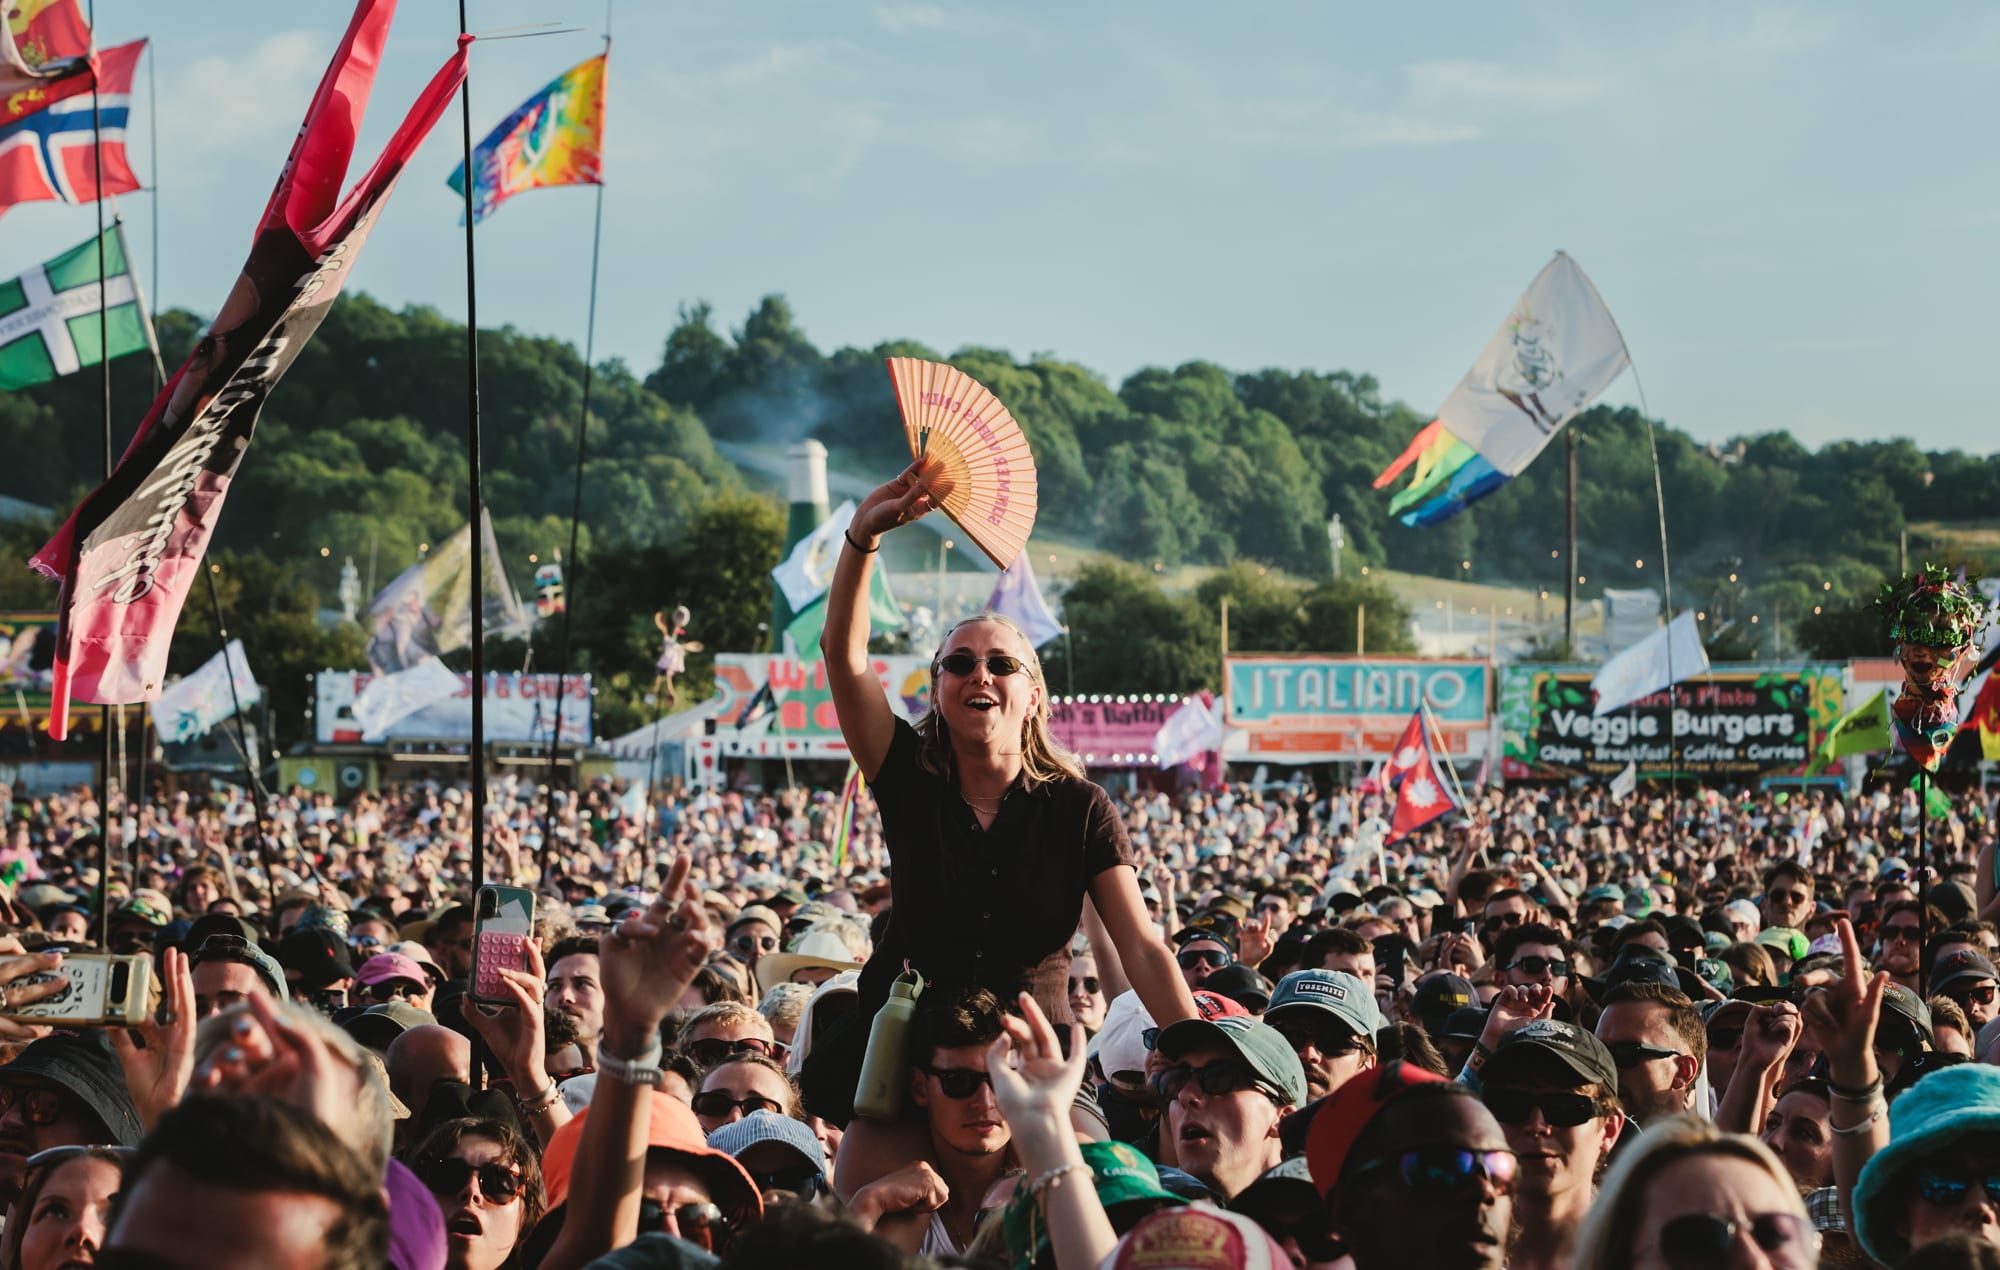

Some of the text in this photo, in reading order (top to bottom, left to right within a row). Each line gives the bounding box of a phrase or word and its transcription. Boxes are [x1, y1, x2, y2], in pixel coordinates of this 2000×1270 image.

[1252, 668, 1467, 709] ITALIANO
[1696, 686, 1756, 706] Plate
[1551, 709, 1795, 746] Veggie Burgers
[1540, 744, 1805, 765] Chips Breakfast Coffee Curries
[1299, 982, 1345, 1000] YOSEMITE
